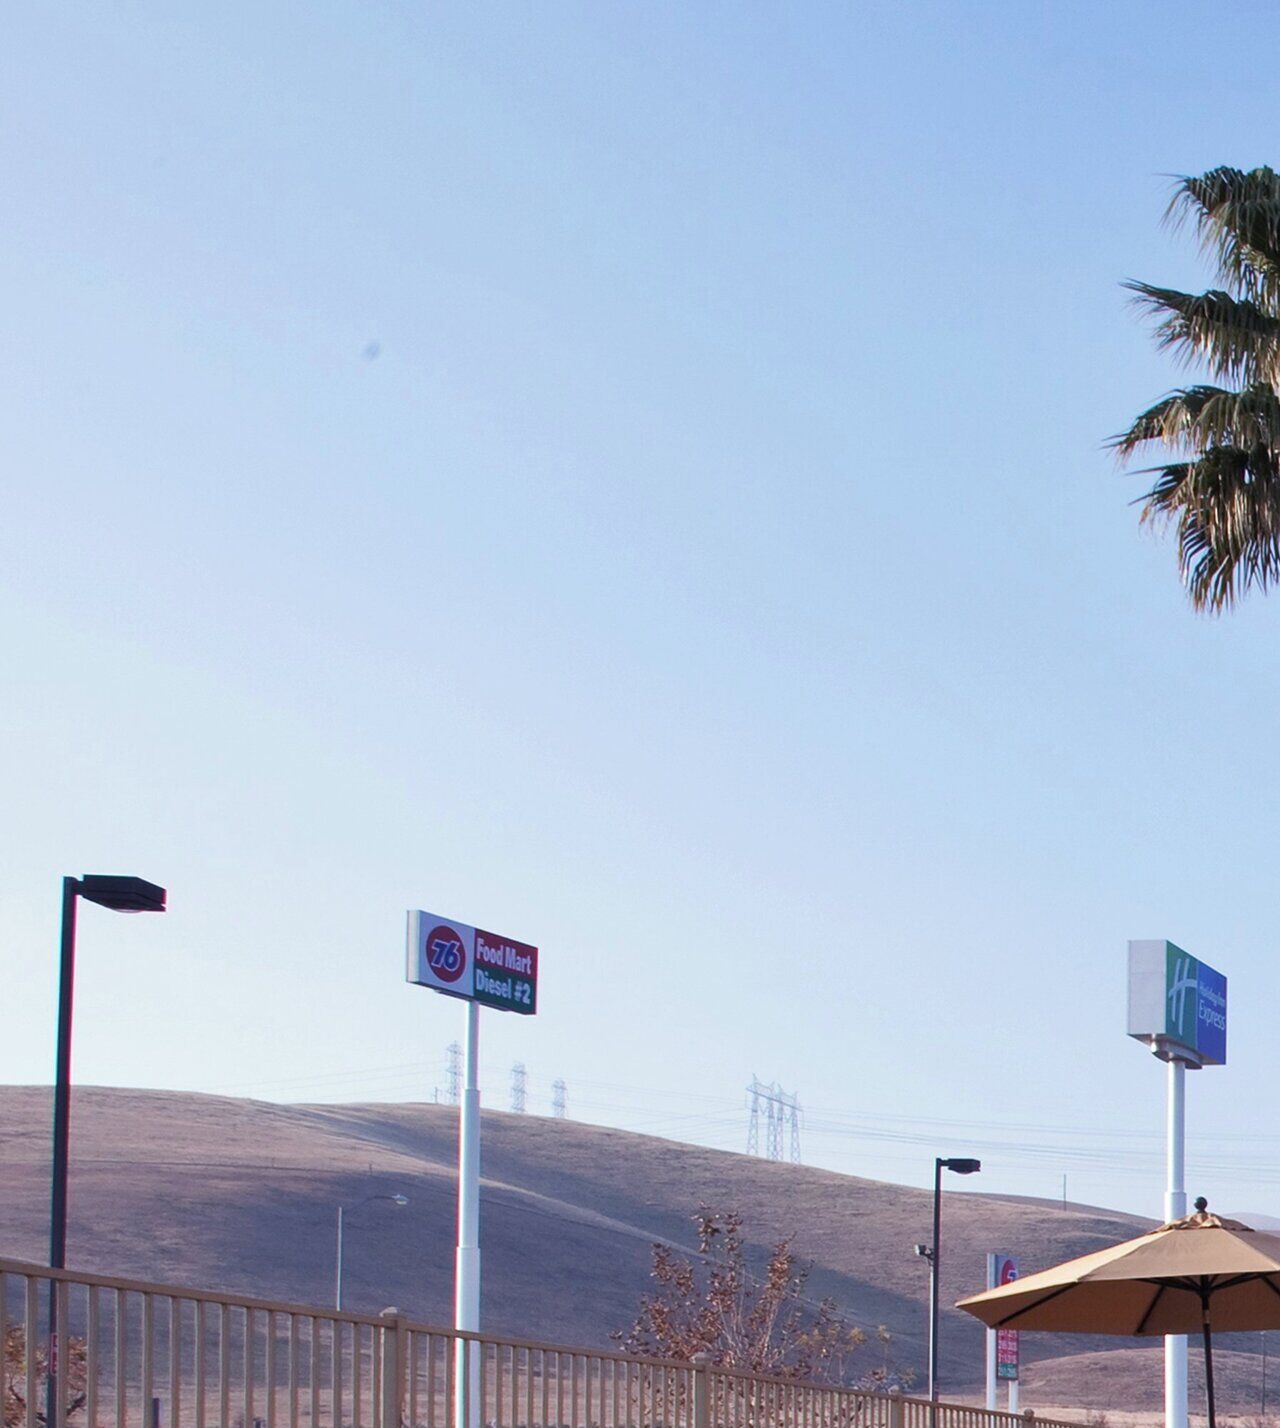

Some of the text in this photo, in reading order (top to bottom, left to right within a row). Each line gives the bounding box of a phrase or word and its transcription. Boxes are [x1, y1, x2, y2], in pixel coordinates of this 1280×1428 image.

[431, 939, 461, 972] 76
[476, 937, 532, 975] Food Mart
[475, 969, 531, 1004] Diesel #2
